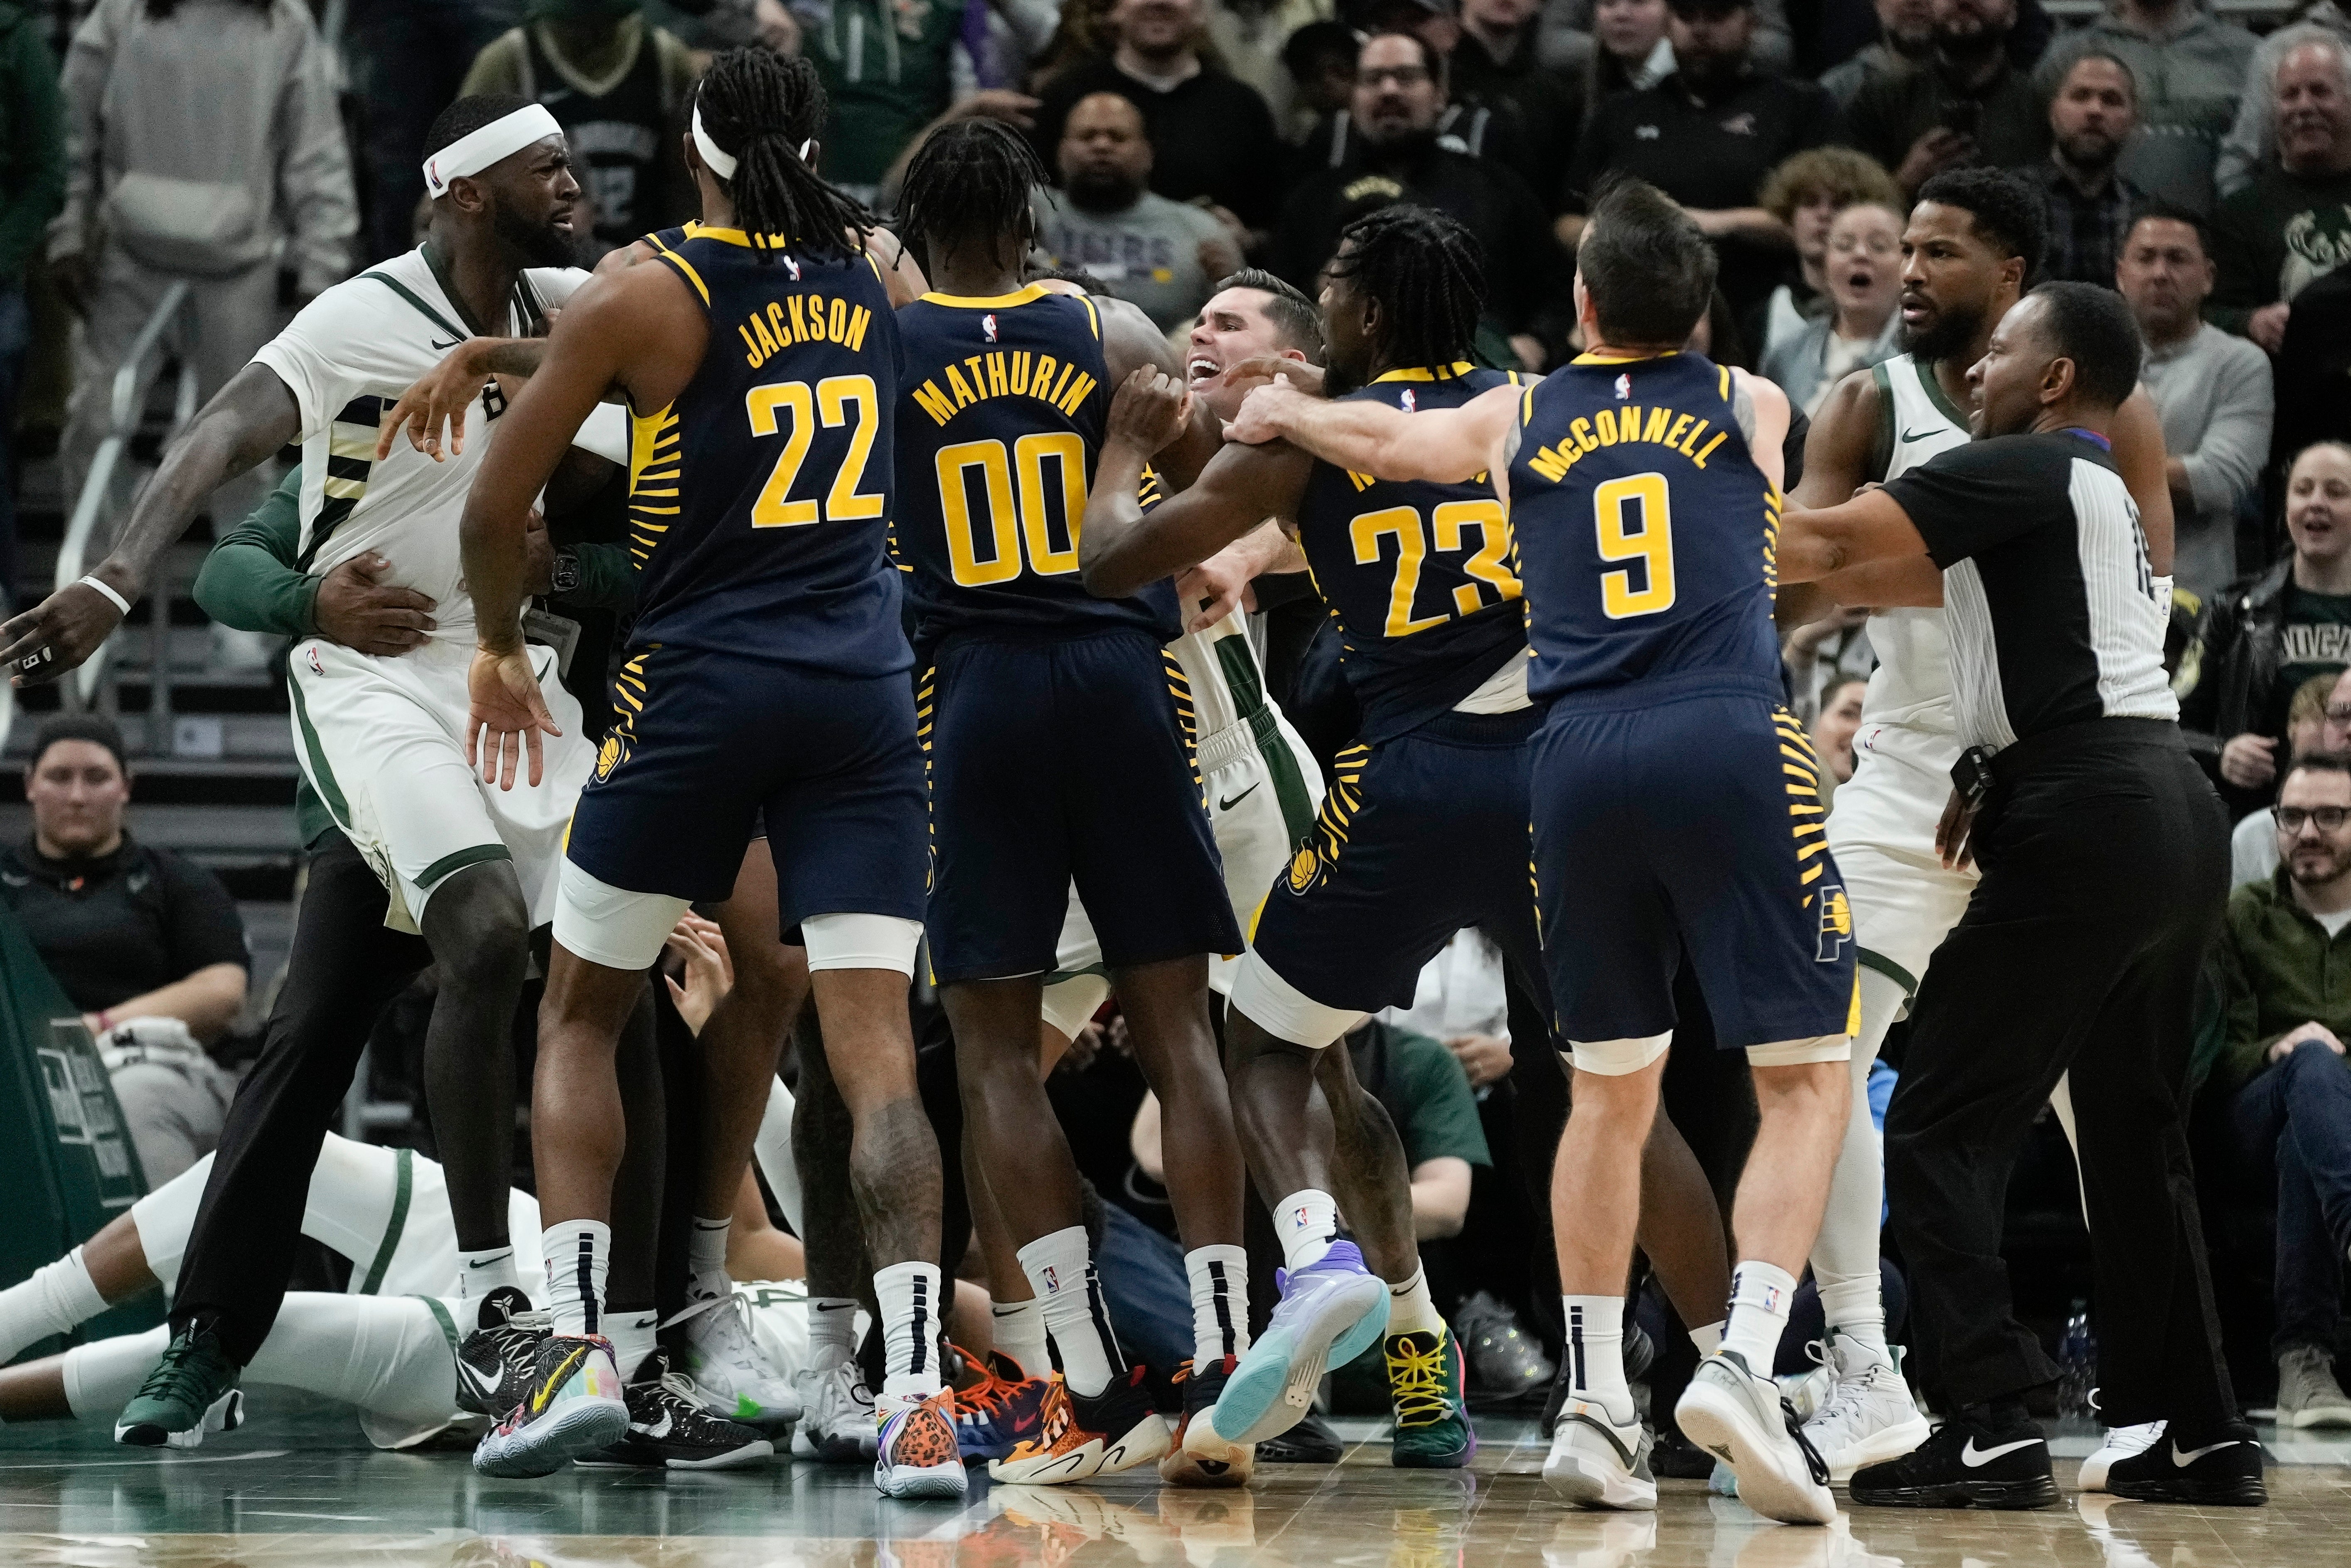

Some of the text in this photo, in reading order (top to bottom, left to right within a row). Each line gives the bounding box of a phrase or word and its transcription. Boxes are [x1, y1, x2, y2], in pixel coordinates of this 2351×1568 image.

[738, 294, 872, 369] JACKSON
[912, 351, 1097, 427] MATHURIN
[745, 374, 885, 529] 22
[935, 432, 1088, 587] 00
[1528, 406, 1728, 483] McCONNELL
[1349, 499, 1523, 638] 23
[1594, 472, 1676, 619] 9
